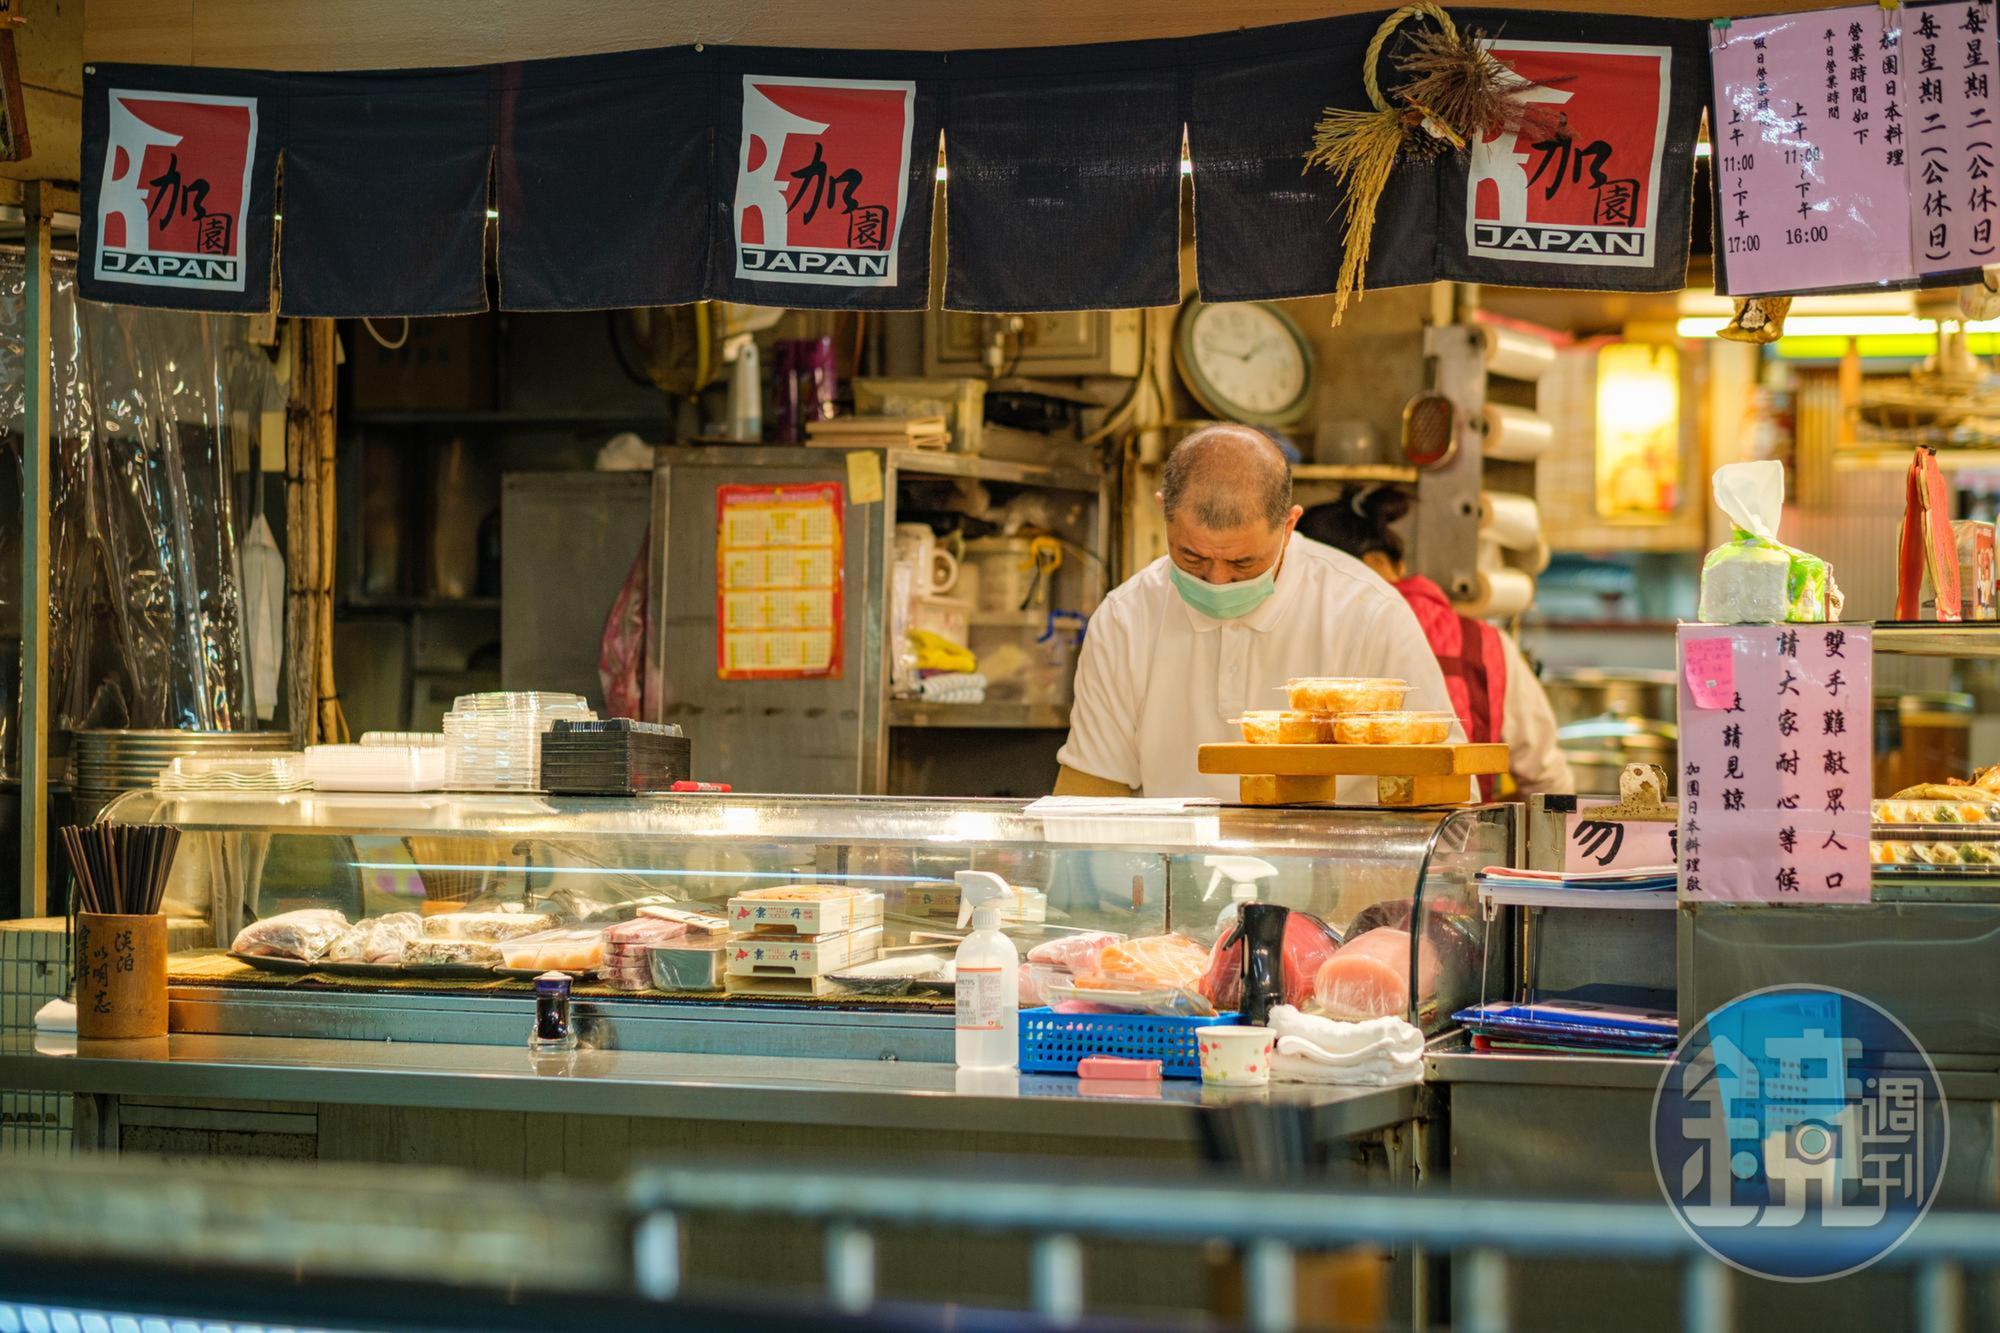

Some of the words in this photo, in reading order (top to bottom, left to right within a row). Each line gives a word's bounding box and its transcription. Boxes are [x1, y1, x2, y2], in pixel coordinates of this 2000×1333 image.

[1848, 22, 1869, 145] 營業時間如下
[1728, 109, 1744, 146] 上午
[1526, 112, 1640, 227] 加園
[1724, 154, 1754, 172] 11:00
[147, 152, 233, 257] 加園
[786, 142, 890, 251] 加園
[1477, 226, 1641, 255] JAPAN
[1728, 235, 1760, 253] 17:00
[1785, 226, 1828, 245] 16:00
[103, 251, 235, 281] JAPAN
[743, 249, 887, 276] JAPAN
[1775, 630, 1800, 893] 請大家耐心等候
[1822, 629, 1849, 889] 雙手難敵眾人口
